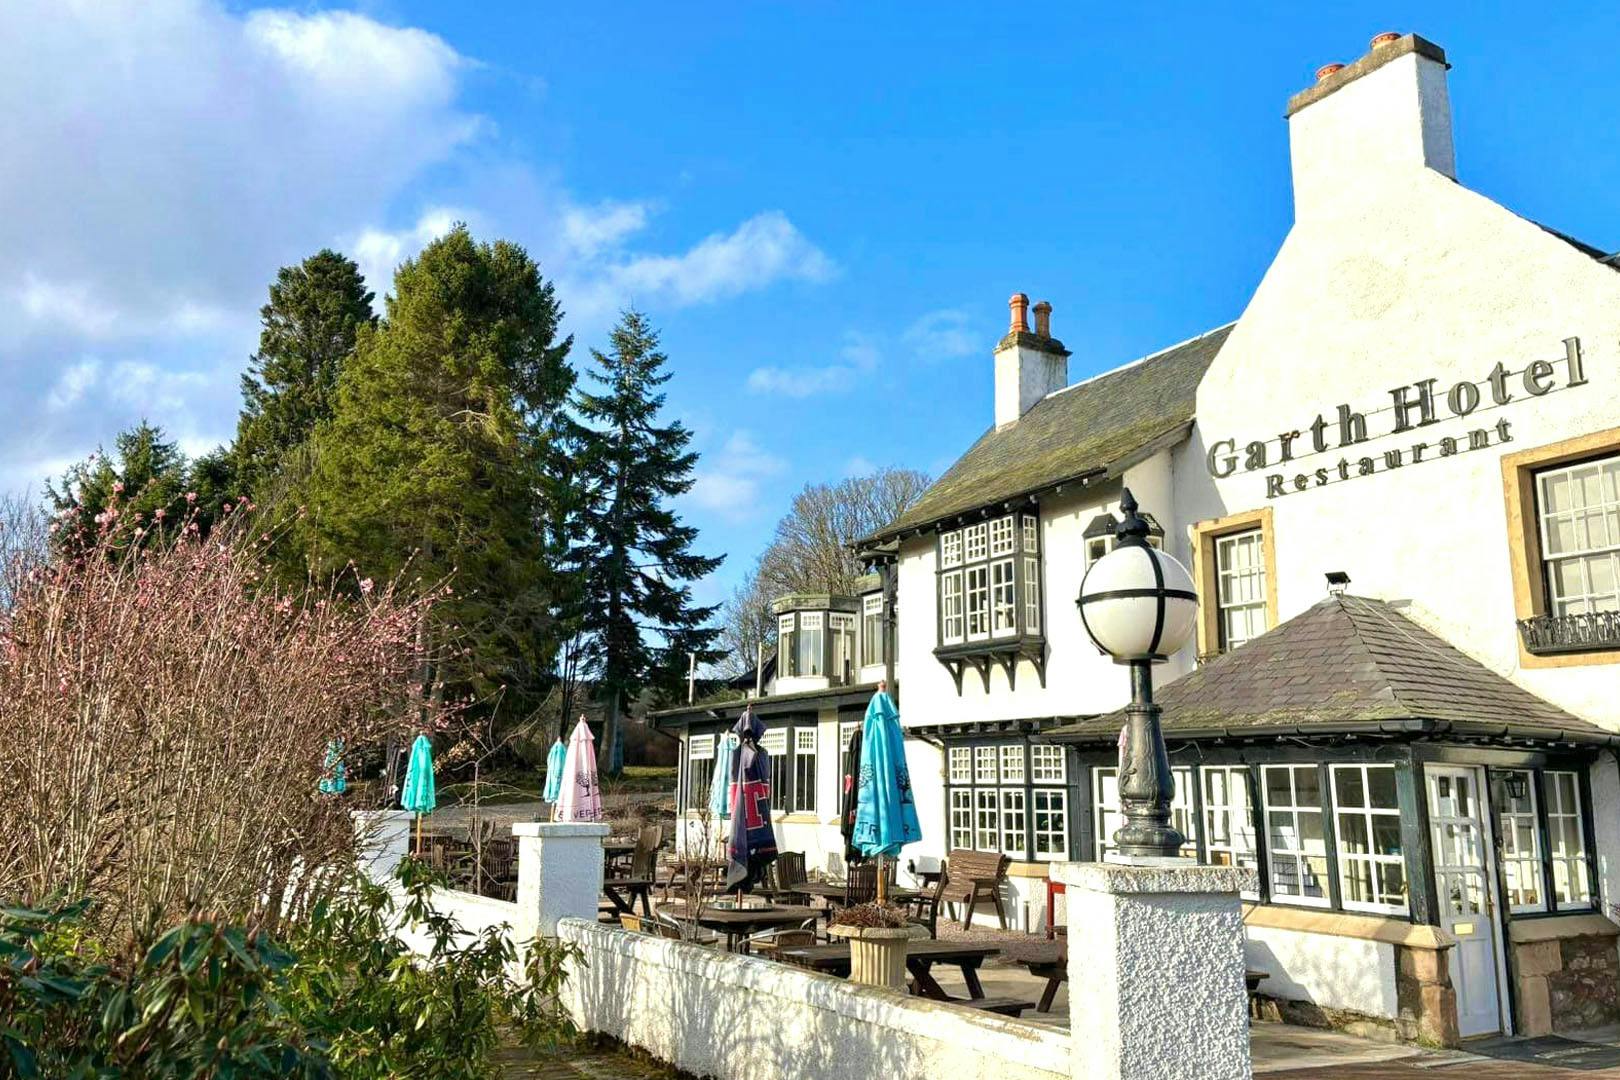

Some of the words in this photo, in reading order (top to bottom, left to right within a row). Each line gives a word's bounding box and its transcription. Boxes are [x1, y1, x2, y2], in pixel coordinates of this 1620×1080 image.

[1206, 403, 1369, 479] Garth
[1388, 336, 1588, 434] Hotel
[1266, 416, 1514, 499] Restaurant
